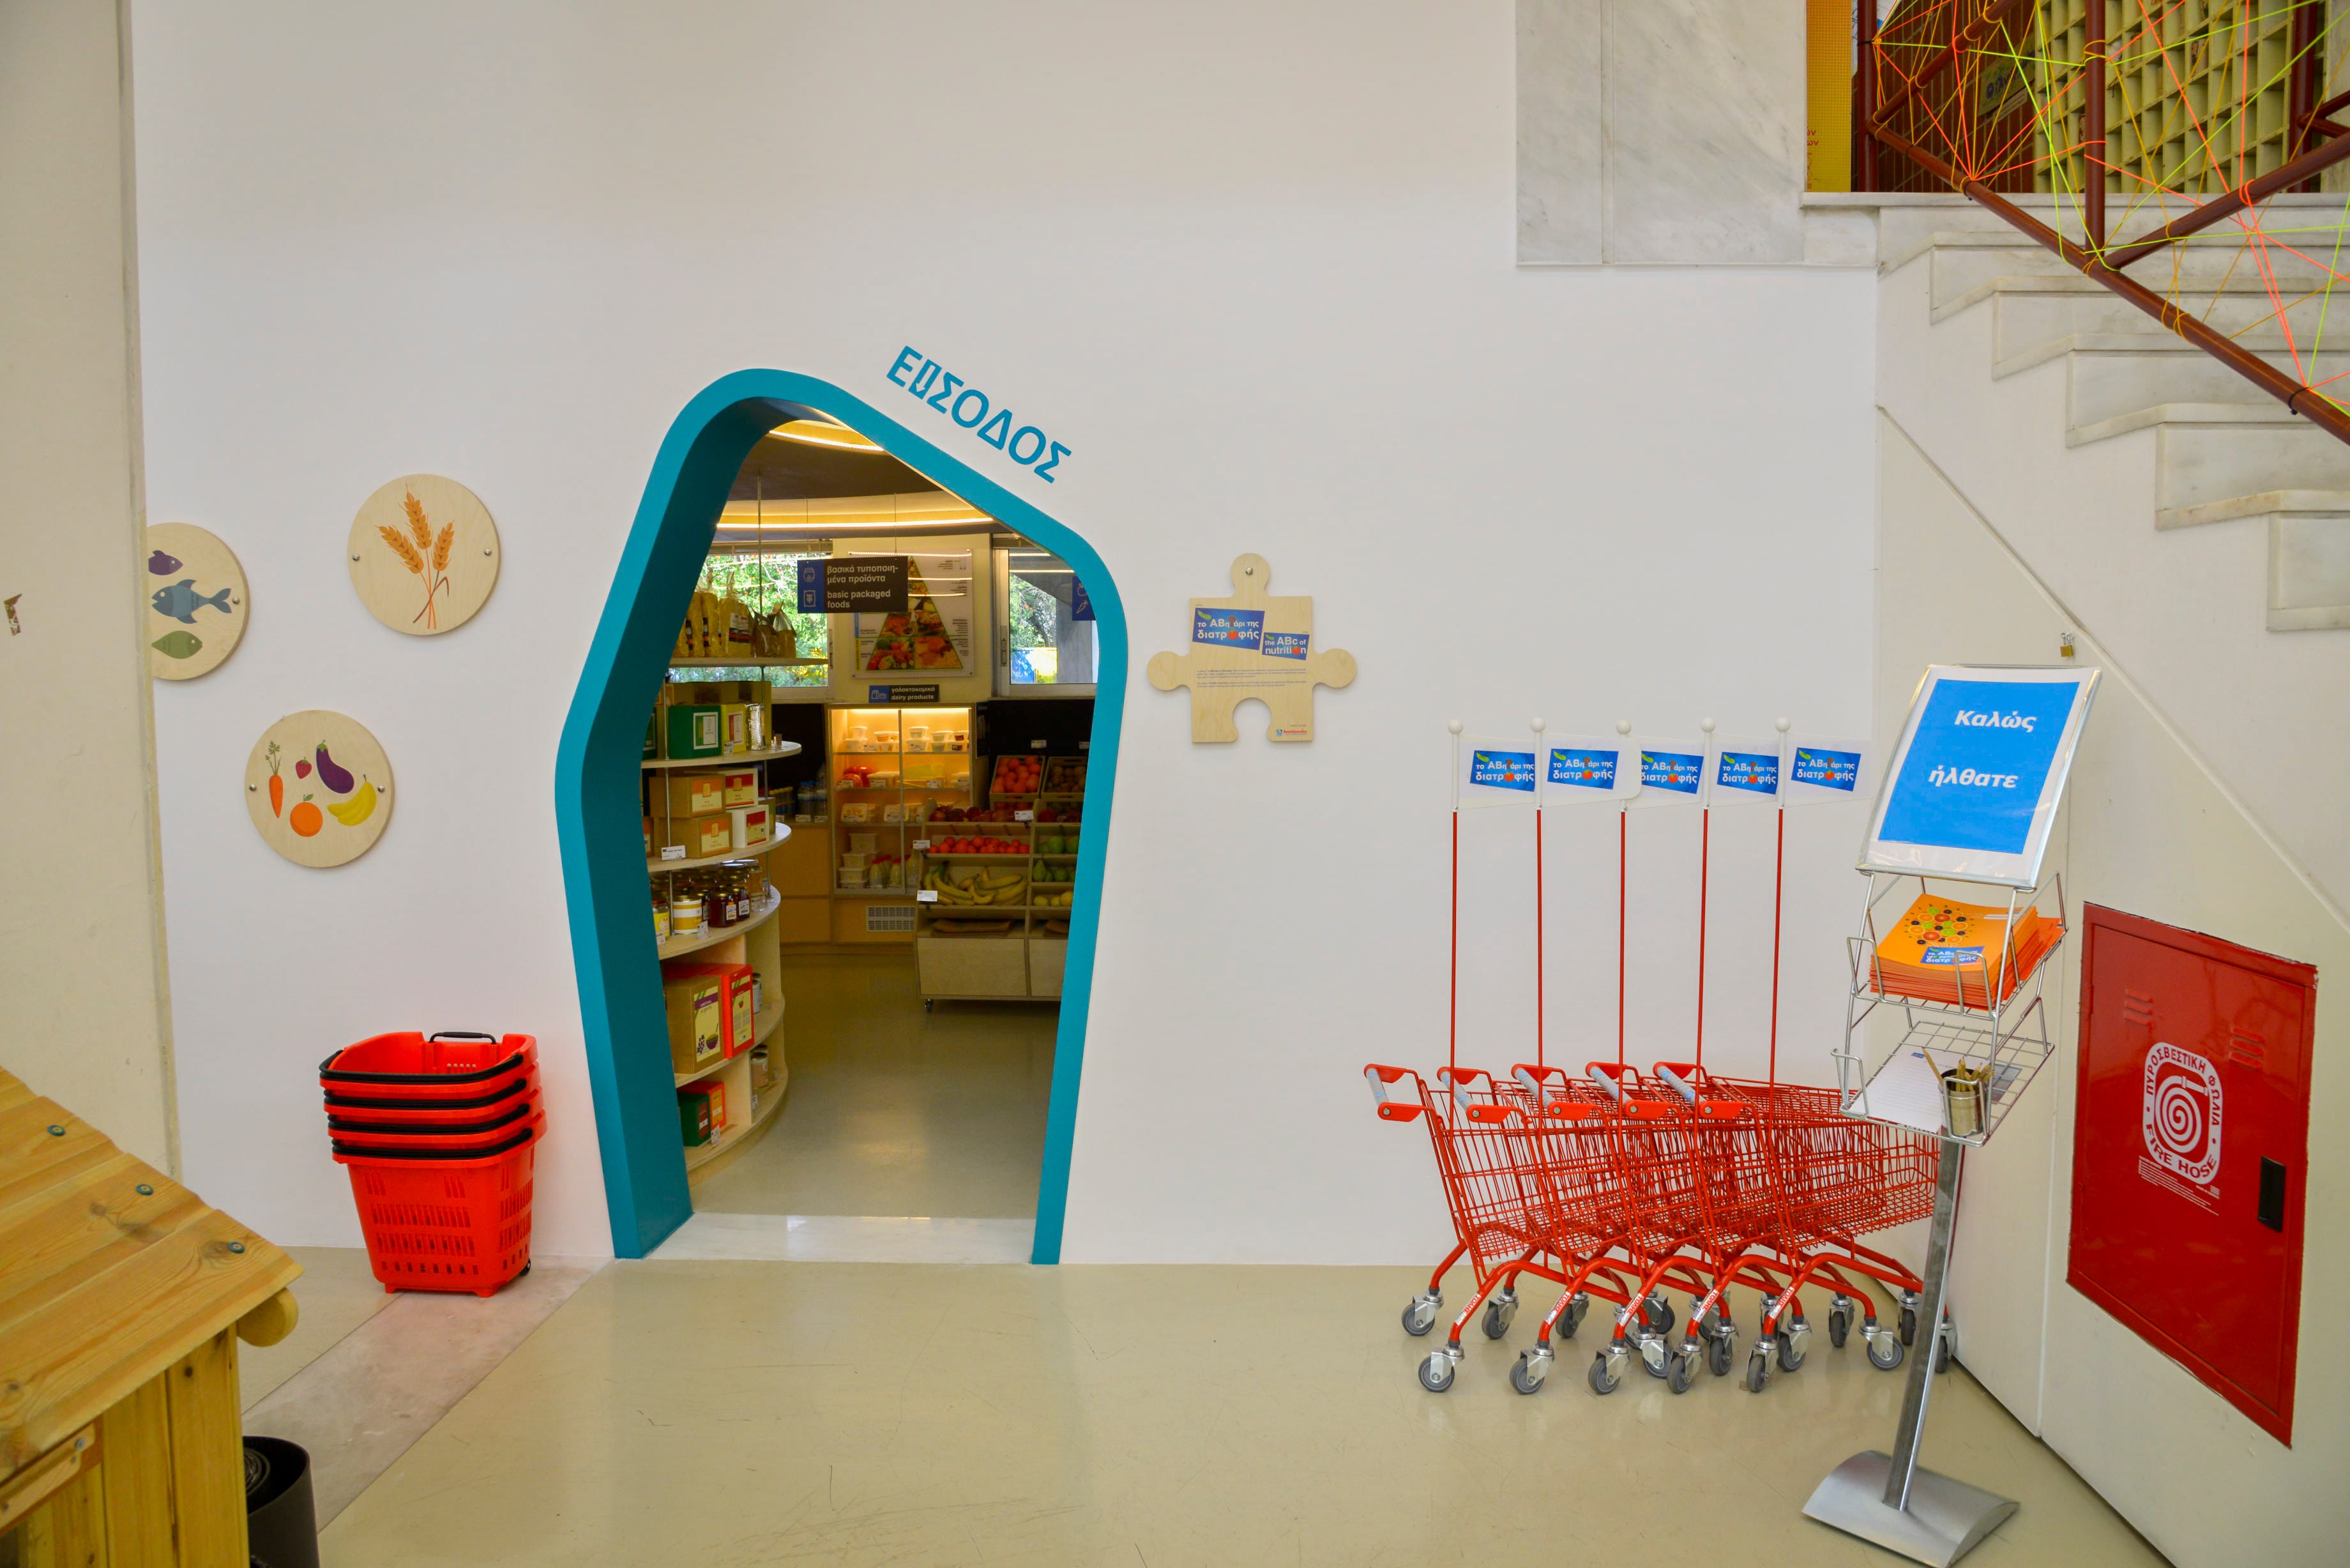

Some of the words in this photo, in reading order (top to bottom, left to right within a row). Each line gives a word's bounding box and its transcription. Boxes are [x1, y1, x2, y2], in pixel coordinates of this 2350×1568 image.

[827, 565, 854, 575] βασικά
[856, 564, 898, 573] τυποποιη-
[827, 575, 846, 585] μένα
[848, 574, 886, 584] προϊόντα
[827, 590, 849, 598] basic
[851, 589, 891, 599] packaged
[1954, 710, 2037, 733] Καλώς
[1928, 765, 2019, 788] ήλθατε
[2145, 1046, 2207, 1096] ΠΥΡΟΣΒΕΣΤΙΚΗ
[2208, 1075, 2220, 1126] ΦΩΛΙΑ
[2146, 1124, 2172, 1166] FIRE
[2178, 1154, 2217, 1179] HOSE
